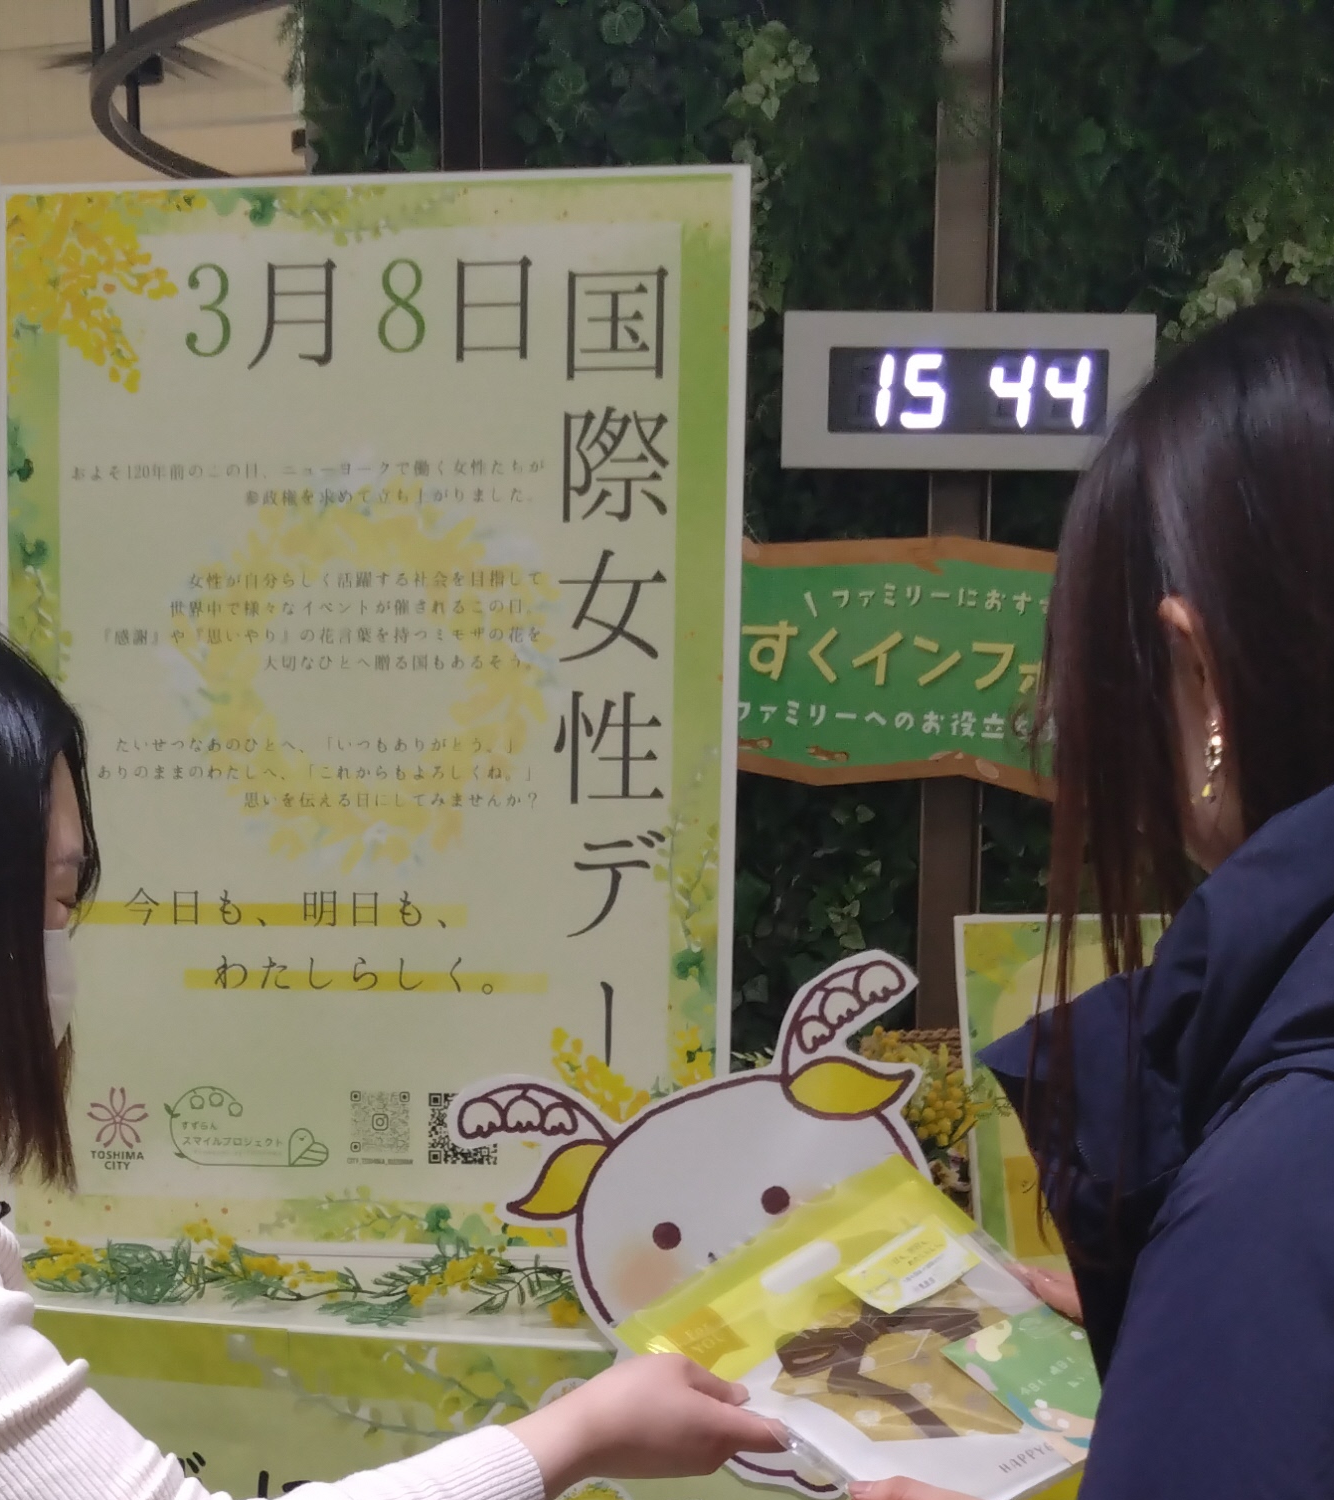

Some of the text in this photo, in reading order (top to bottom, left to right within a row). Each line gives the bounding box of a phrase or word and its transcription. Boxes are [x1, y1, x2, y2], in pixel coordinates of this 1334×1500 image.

[185, 255, 533, 371] 3月8日
[875, 352, 1091, 430] 15 44
[553, 264, 669, 1068] 国際女性デー
[213, 954, 495, 996] わたしらしく。
[90, 1150, 145, 1161] TOSHIMA
[181, 1136, 284, 1148] スマイルプロジェクト
[104, 1160, 131, 1171] CITY
